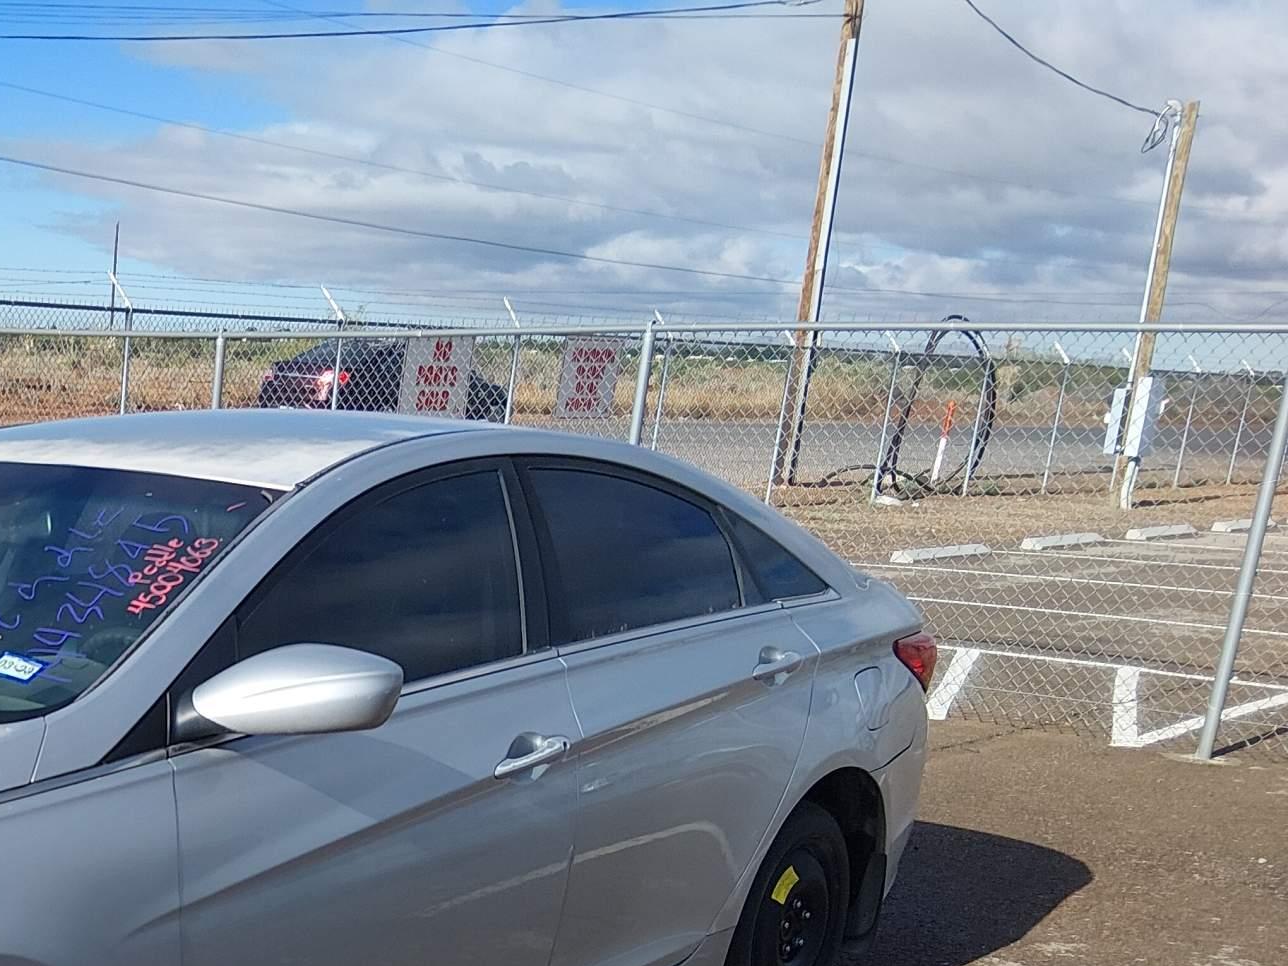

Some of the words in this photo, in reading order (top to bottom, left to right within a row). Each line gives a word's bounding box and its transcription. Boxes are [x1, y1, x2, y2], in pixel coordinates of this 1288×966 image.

[416, 365, 458, 387] PARTS
[416, 390, 450, 411] SOLD
[127, 538, 218, 614] 45004063
